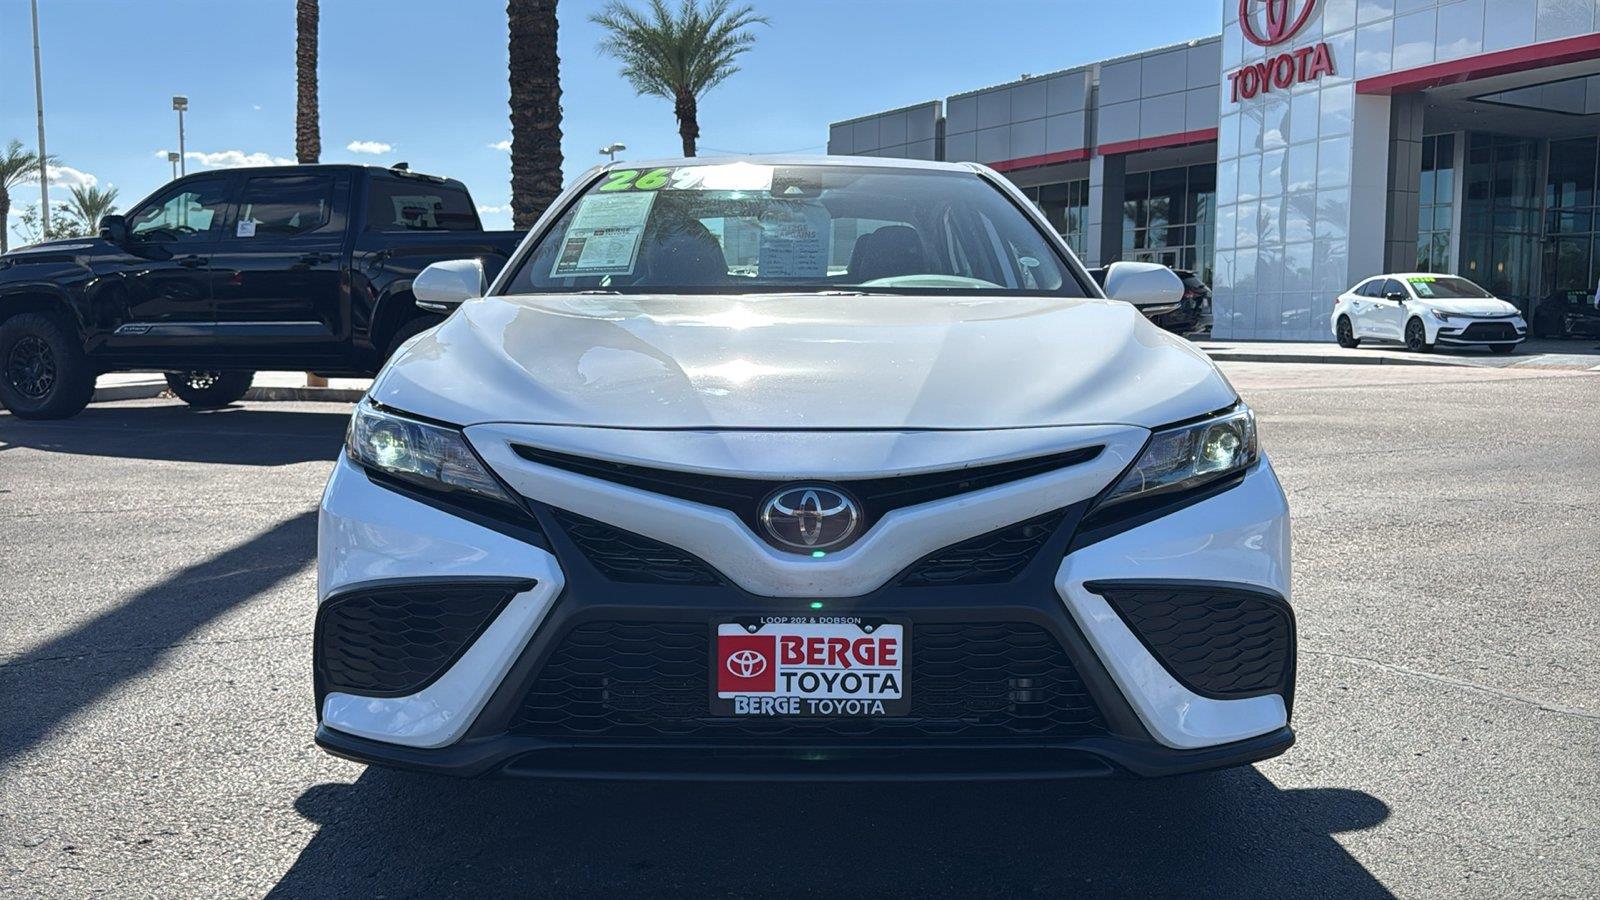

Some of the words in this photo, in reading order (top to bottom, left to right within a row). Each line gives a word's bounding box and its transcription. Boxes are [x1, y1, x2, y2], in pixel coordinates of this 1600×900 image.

[1227, 42, 1335, 104] TOYOTA
[760, 616, 788, 624] LOOP
[790, 616, 807, 624] 202
[809, 616, 816, 624] &
[819, 616, 862, 625] DOBSON
[780, 635, 898, 669] BERGE
[780, 671, 900, 694] TOYOTA
[734, 696, 801, 716] BERGE
[807, 699, 885, 715] TOYOTA
